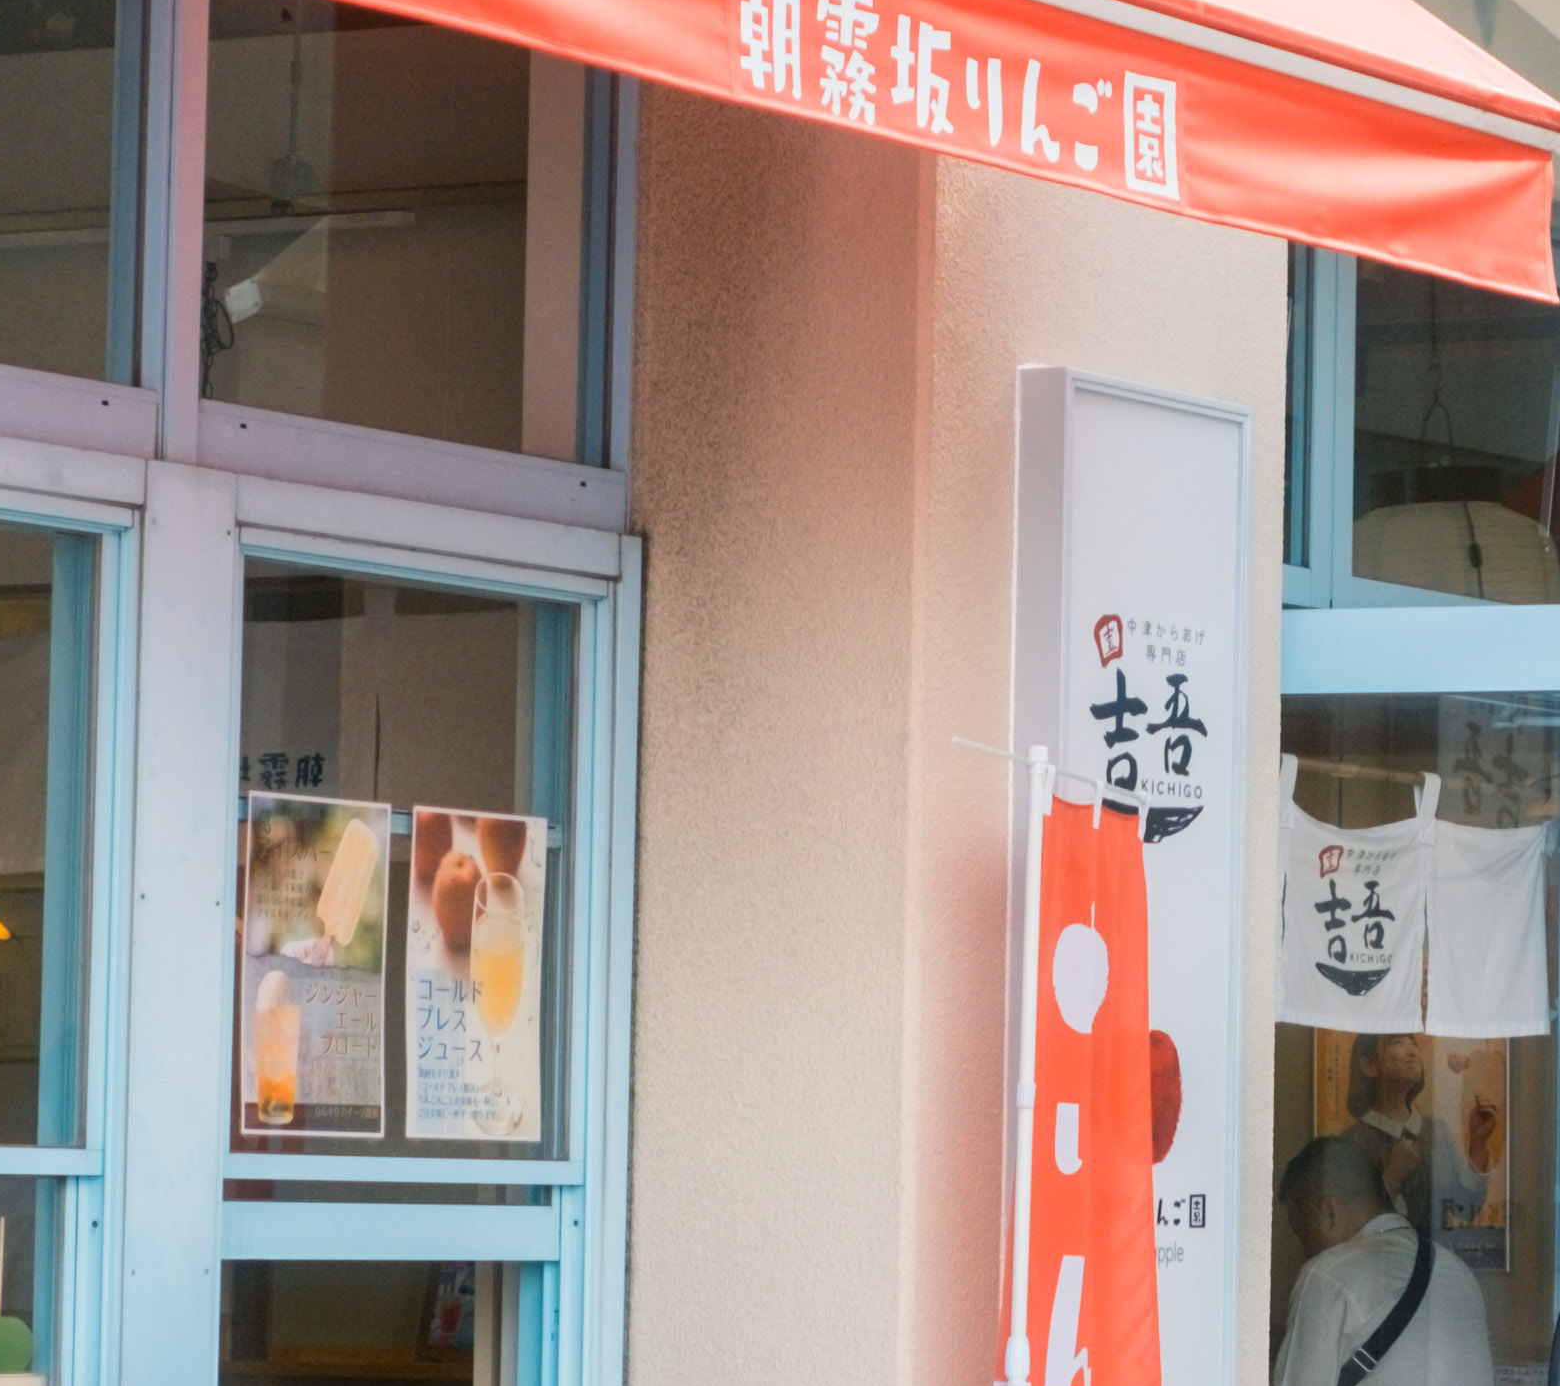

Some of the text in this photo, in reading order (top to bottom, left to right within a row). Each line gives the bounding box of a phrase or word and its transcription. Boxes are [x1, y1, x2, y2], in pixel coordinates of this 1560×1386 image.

[1141, 778, 1203, 800] KICHIGO
[418, 979, 484, 1004] コールド
[418, 1005, 467, 1033] プレス
[418, 1036, 483, 1062] ジュース
[1156, 1240, 1184, 1269] pple
